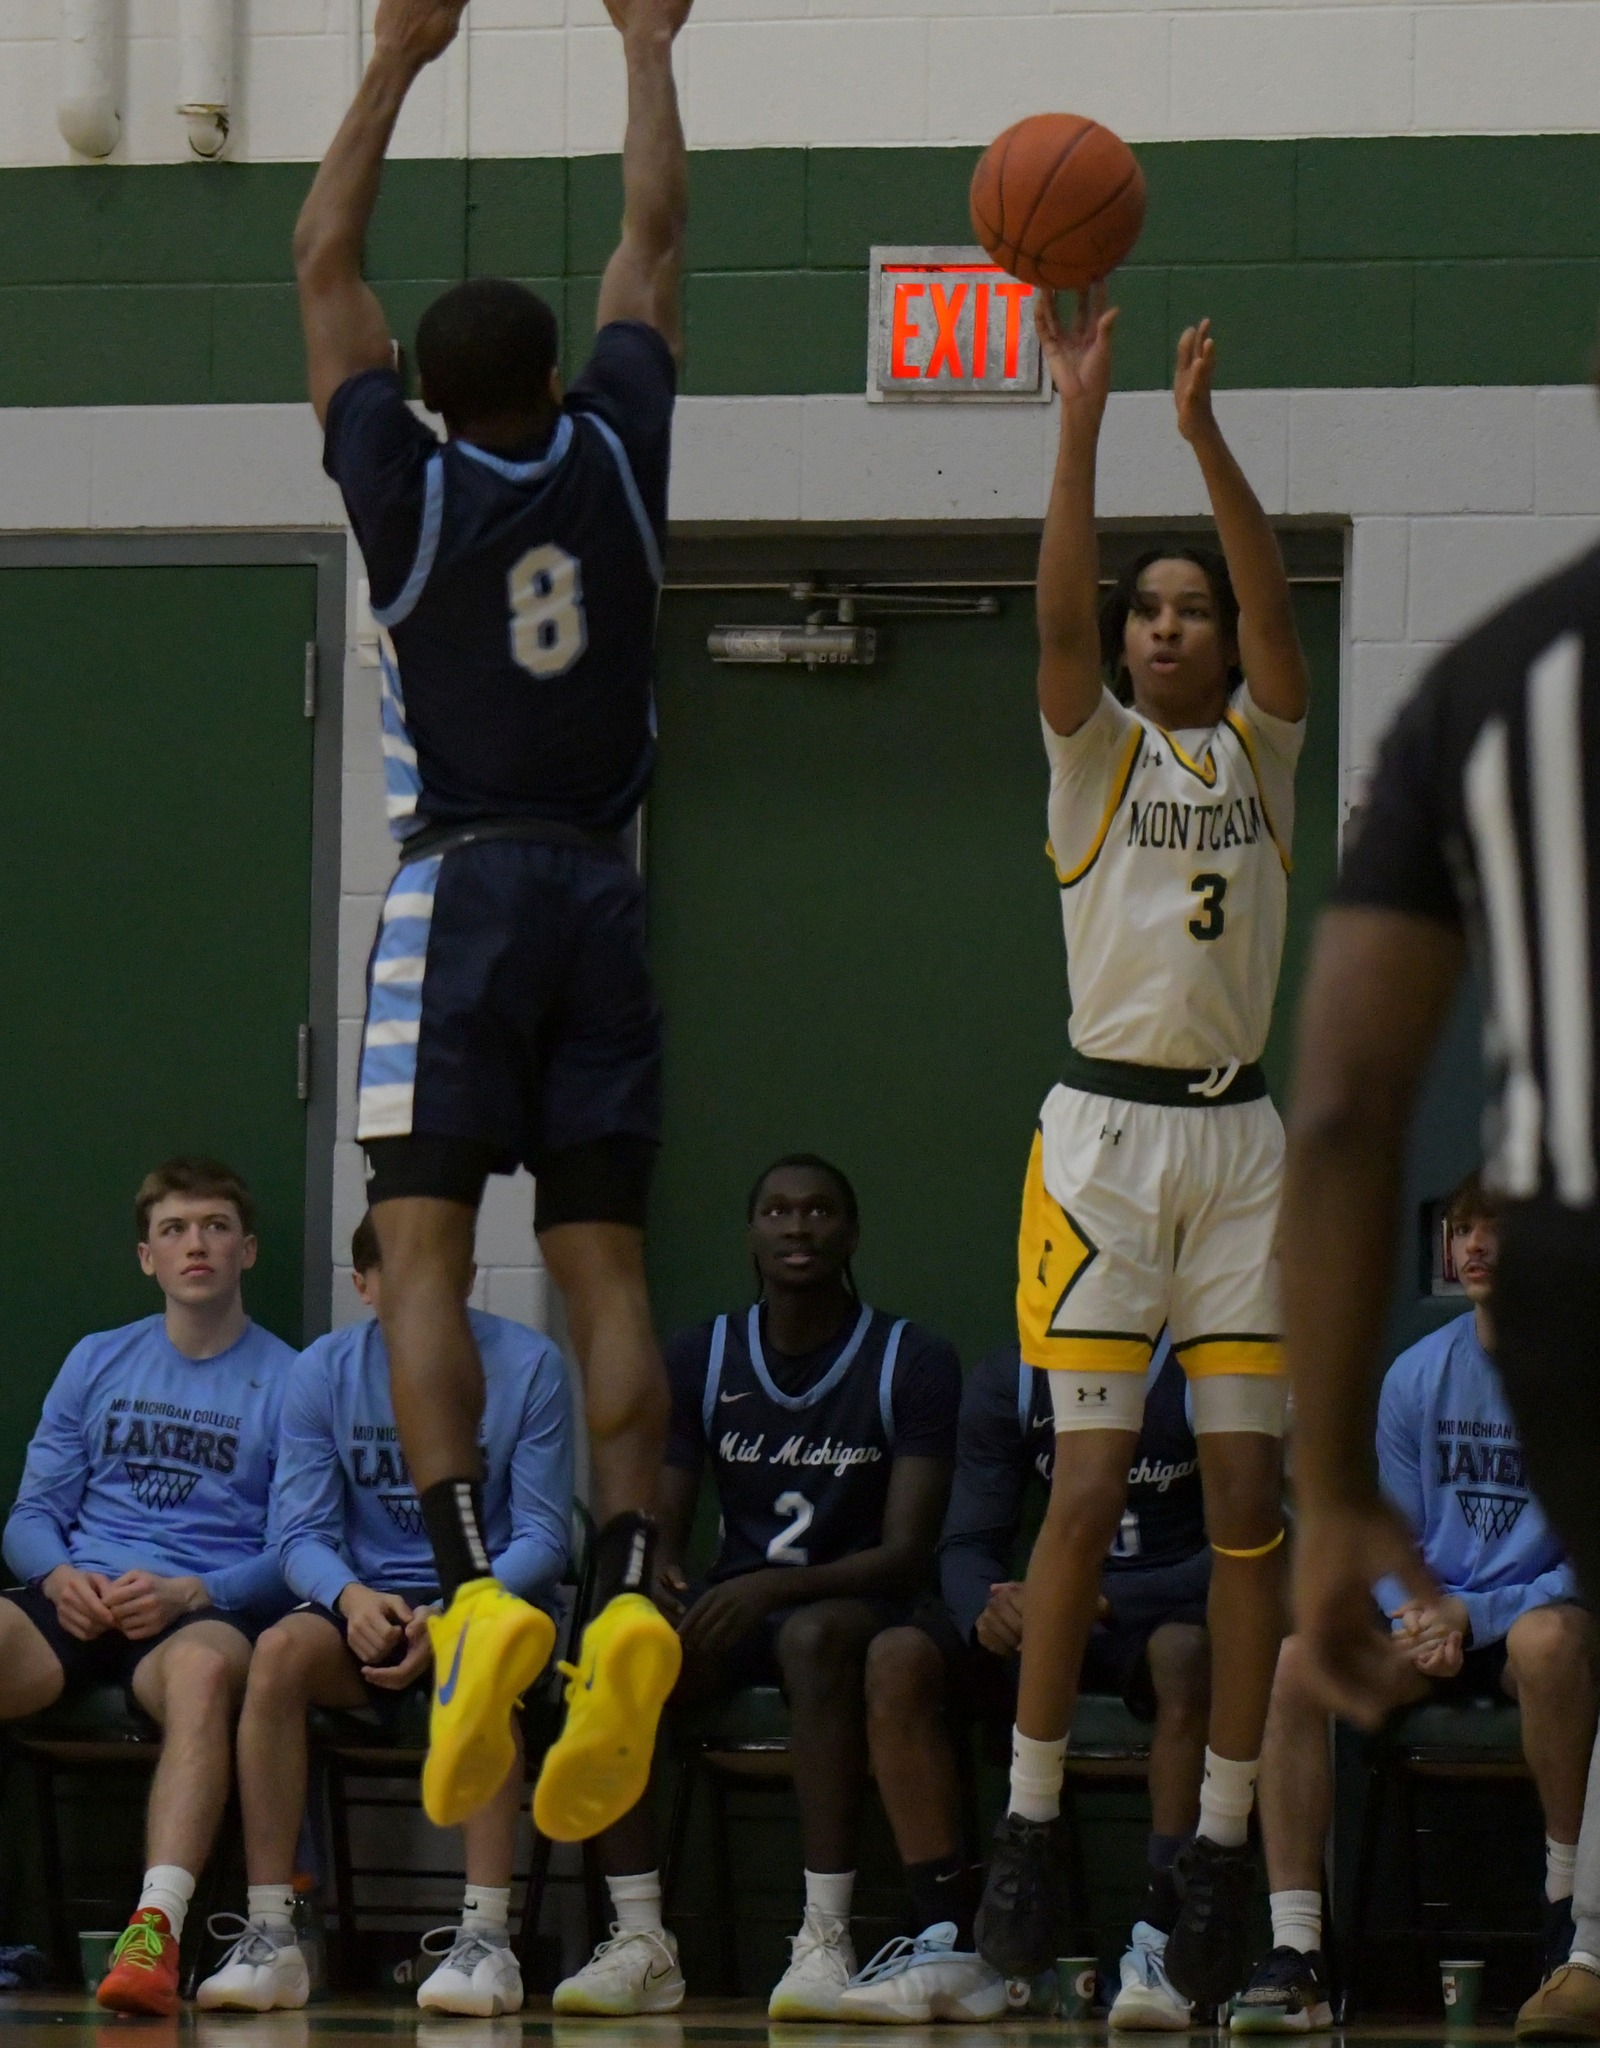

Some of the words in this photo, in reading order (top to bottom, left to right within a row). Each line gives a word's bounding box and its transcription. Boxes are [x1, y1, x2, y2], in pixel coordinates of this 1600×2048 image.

[891, 283, 1033, 379] EXIT
[508, 542, 588, 679] 8
[1189, 872, 1228, 941] 3
[103, 1416, 241, 1476] LAKERS
[133, 1400, 192, 1421] MICHIGAN
[193, 1409, 243, 1430] COLLEGE
[353, 1425, 374, 1441] MID
[719, 1431, 765, 1463] Mid
[769, 1435, 882, 1477] Michigan
[766, 1490, 815, 1566] 2
